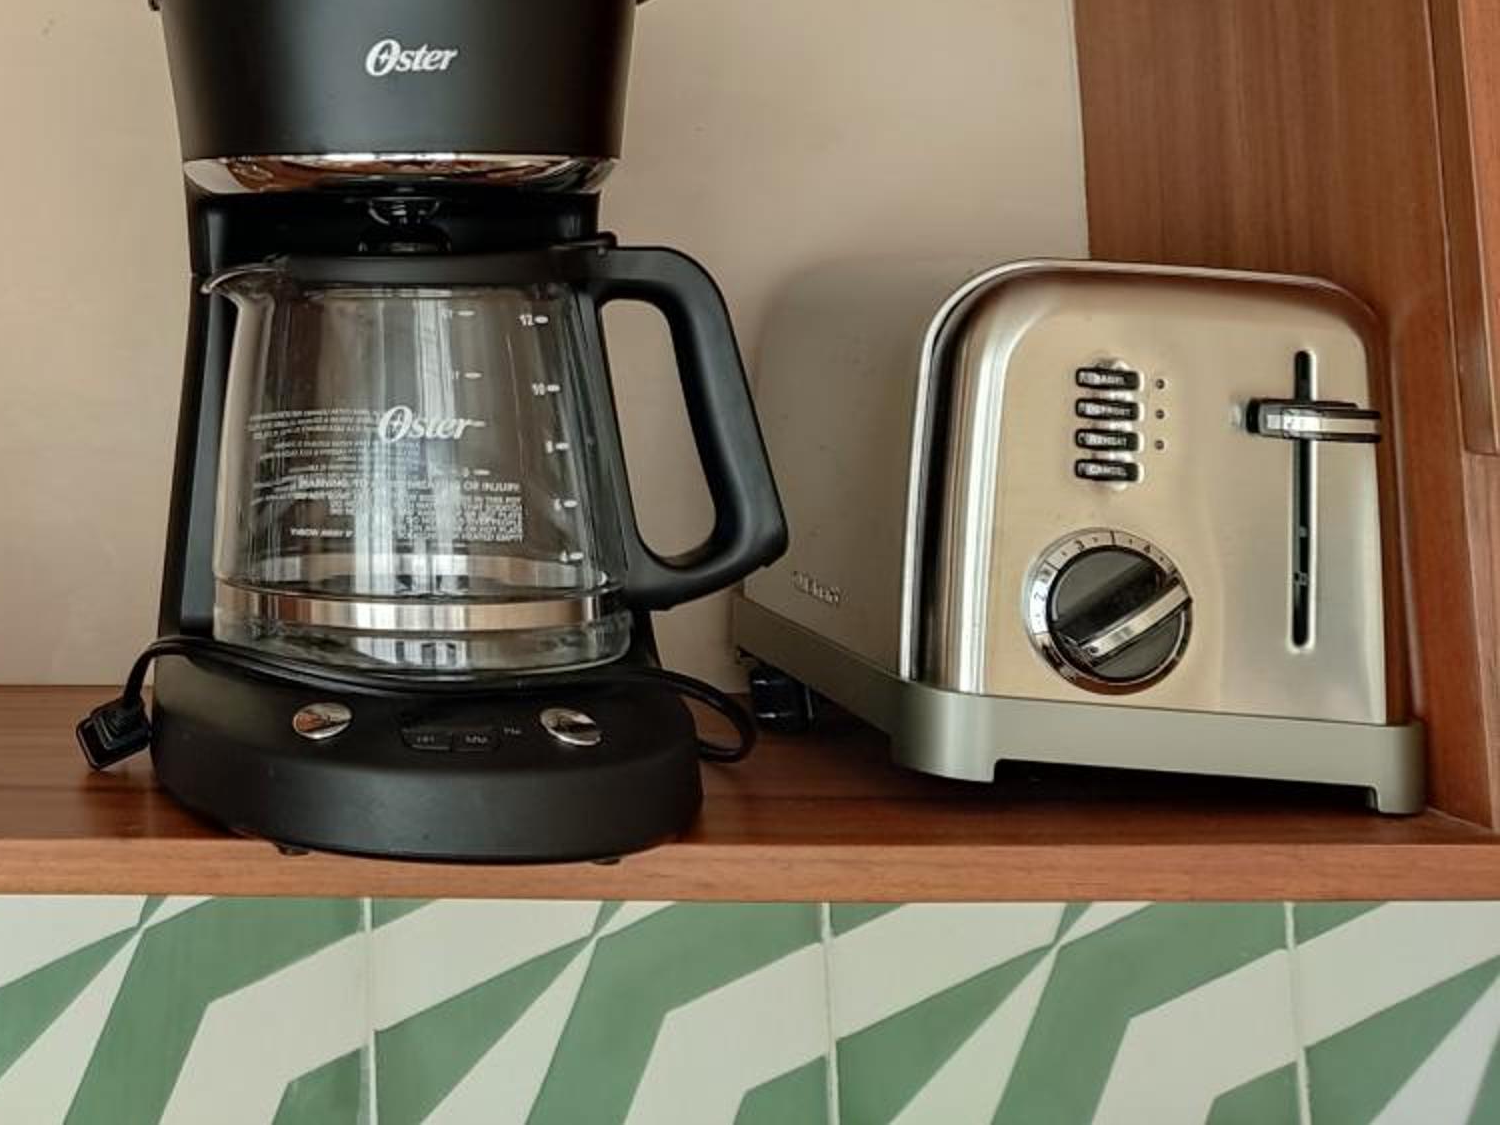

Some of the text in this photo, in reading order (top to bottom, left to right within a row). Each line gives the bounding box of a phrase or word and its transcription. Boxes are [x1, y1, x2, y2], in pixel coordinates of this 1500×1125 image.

[365, 38, 458, 77] Oster
[518, 314, 534, 325] 12
[378, 404, 472, 443] Oster
